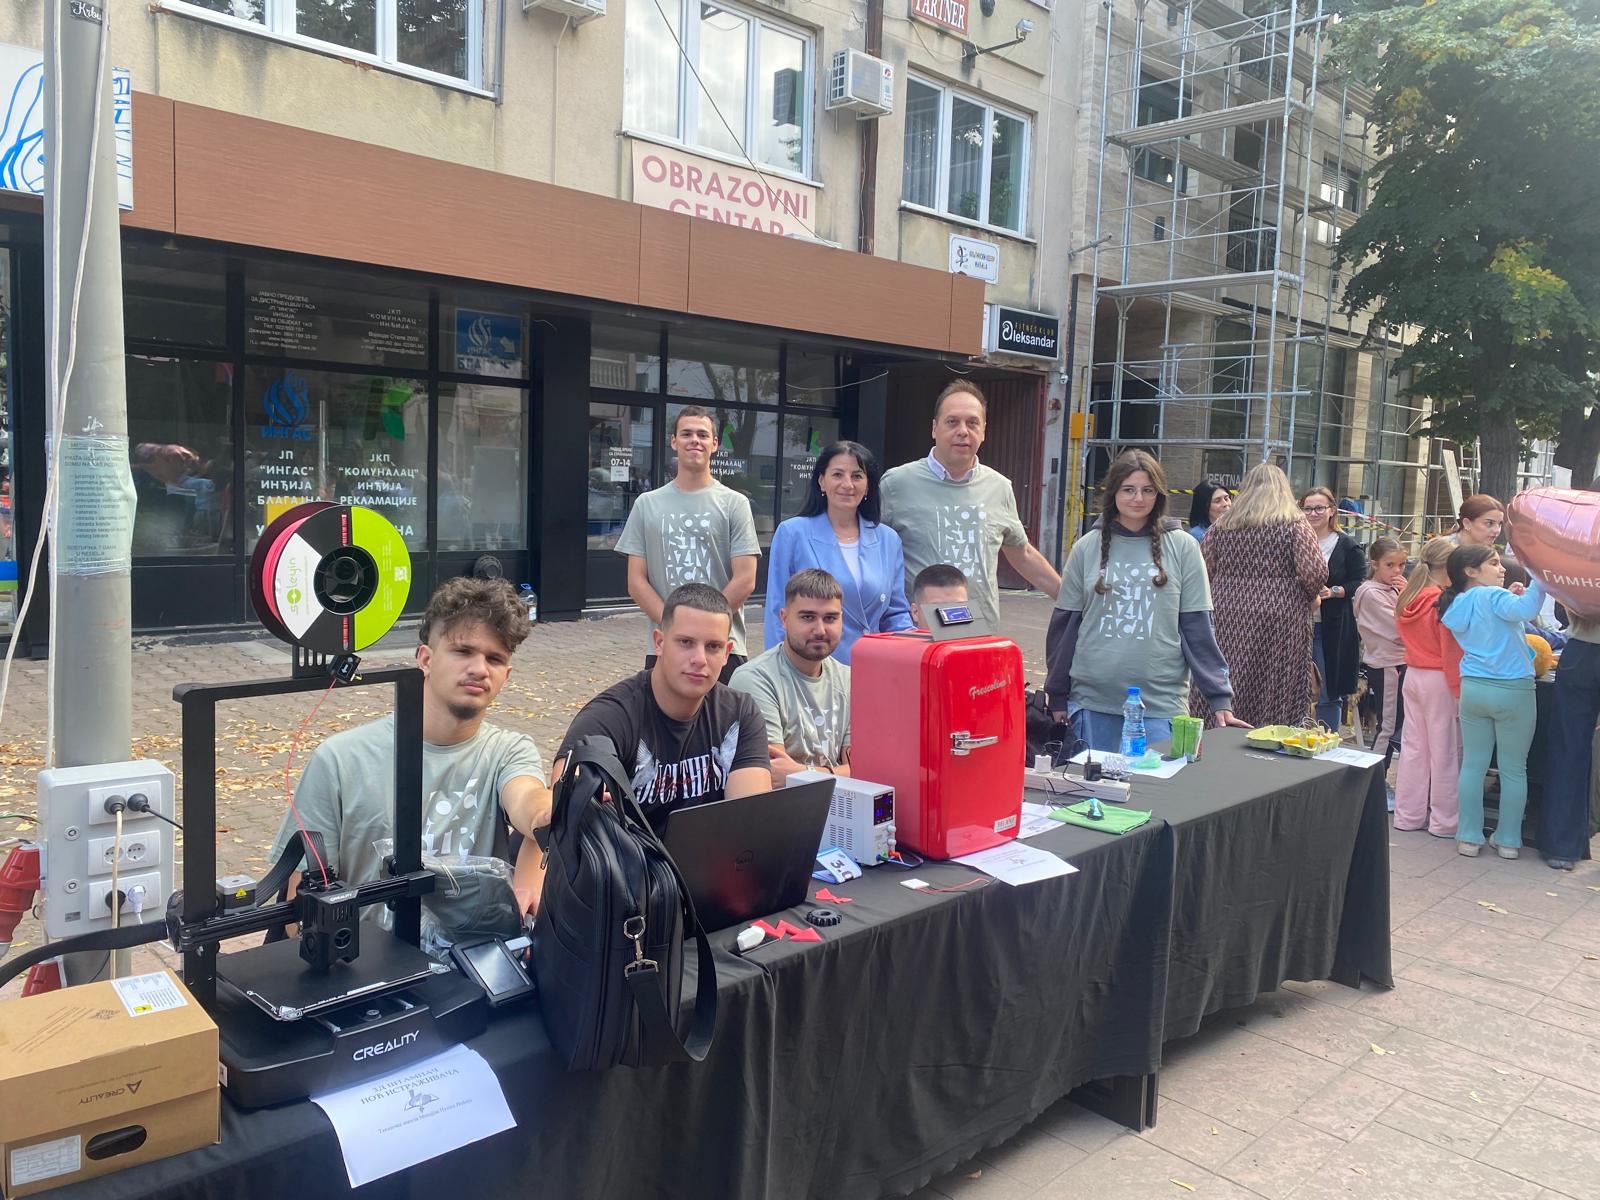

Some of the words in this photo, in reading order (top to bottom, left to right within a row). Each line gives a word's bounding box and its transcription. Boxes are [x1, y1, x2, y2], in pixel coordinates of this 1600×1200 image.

[642, 155, 808, 220] OBRAZOVNI
[261, 426, 312, 440] ИНГАС
[278, 450, 294, 460] ЈП
[370, 454, 390, 462] ЈКП
[610, 458, 630, 466] 07-14
[261, 480, 312, 492] ИНЂИЈА
[358, 482, 402, 492] ИНЂИЈА
[340, 496, 417, 506] РЕКЛАМАЦИЈЕ
[353, 1030, 420, 1061] CREALITY
[385, 1068, 460, 1096] ИСТРАЖИВАЧА
[78, 1088, 126, 1105] CREALITY
